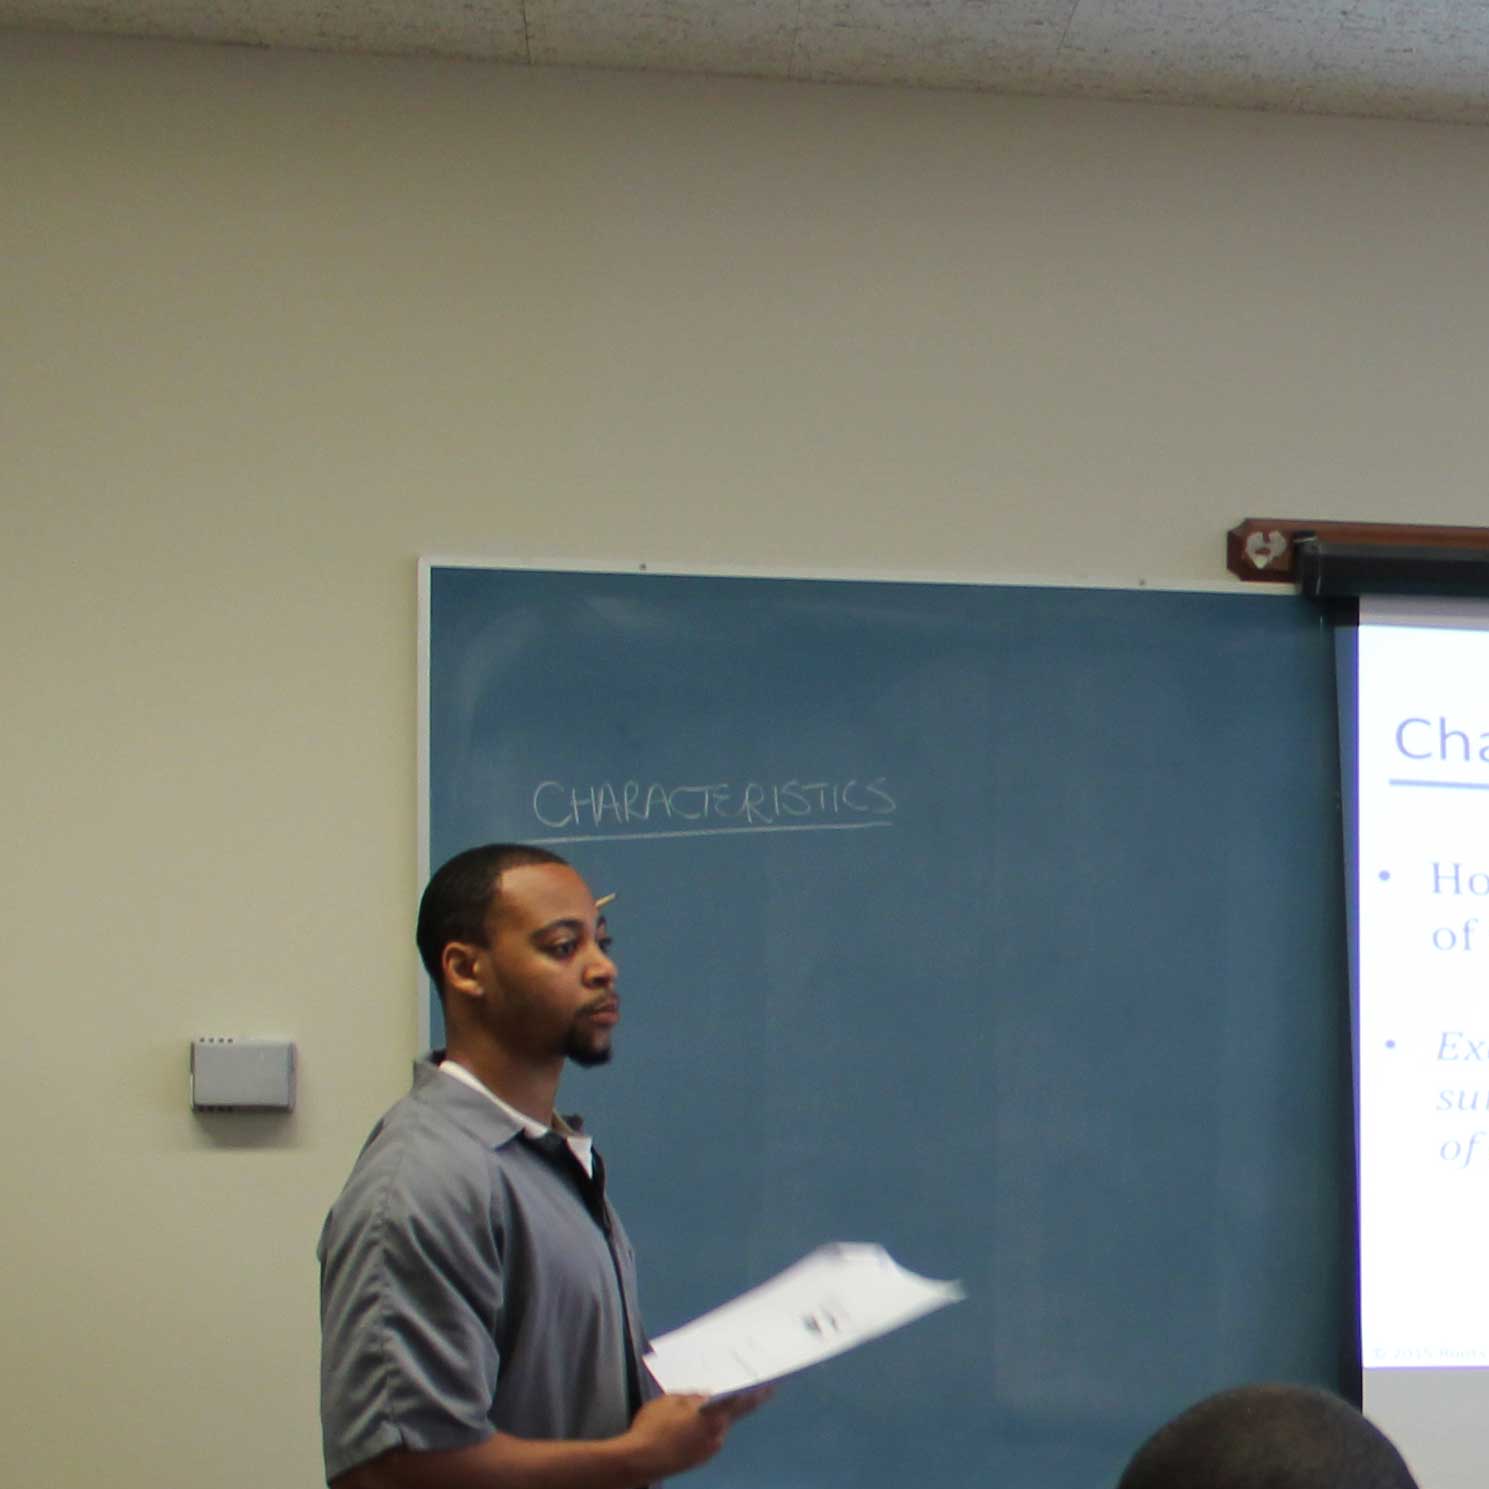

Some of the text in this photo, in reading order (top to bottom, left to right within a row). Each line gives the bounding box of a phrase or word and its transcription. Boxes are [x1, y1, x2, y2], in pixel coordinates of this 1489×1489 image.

[533, 778, 896, 828] CHARACTERISTICS
[1430, 916, 1481, 953] of
[1439, 1130, 1488, 1169] of
